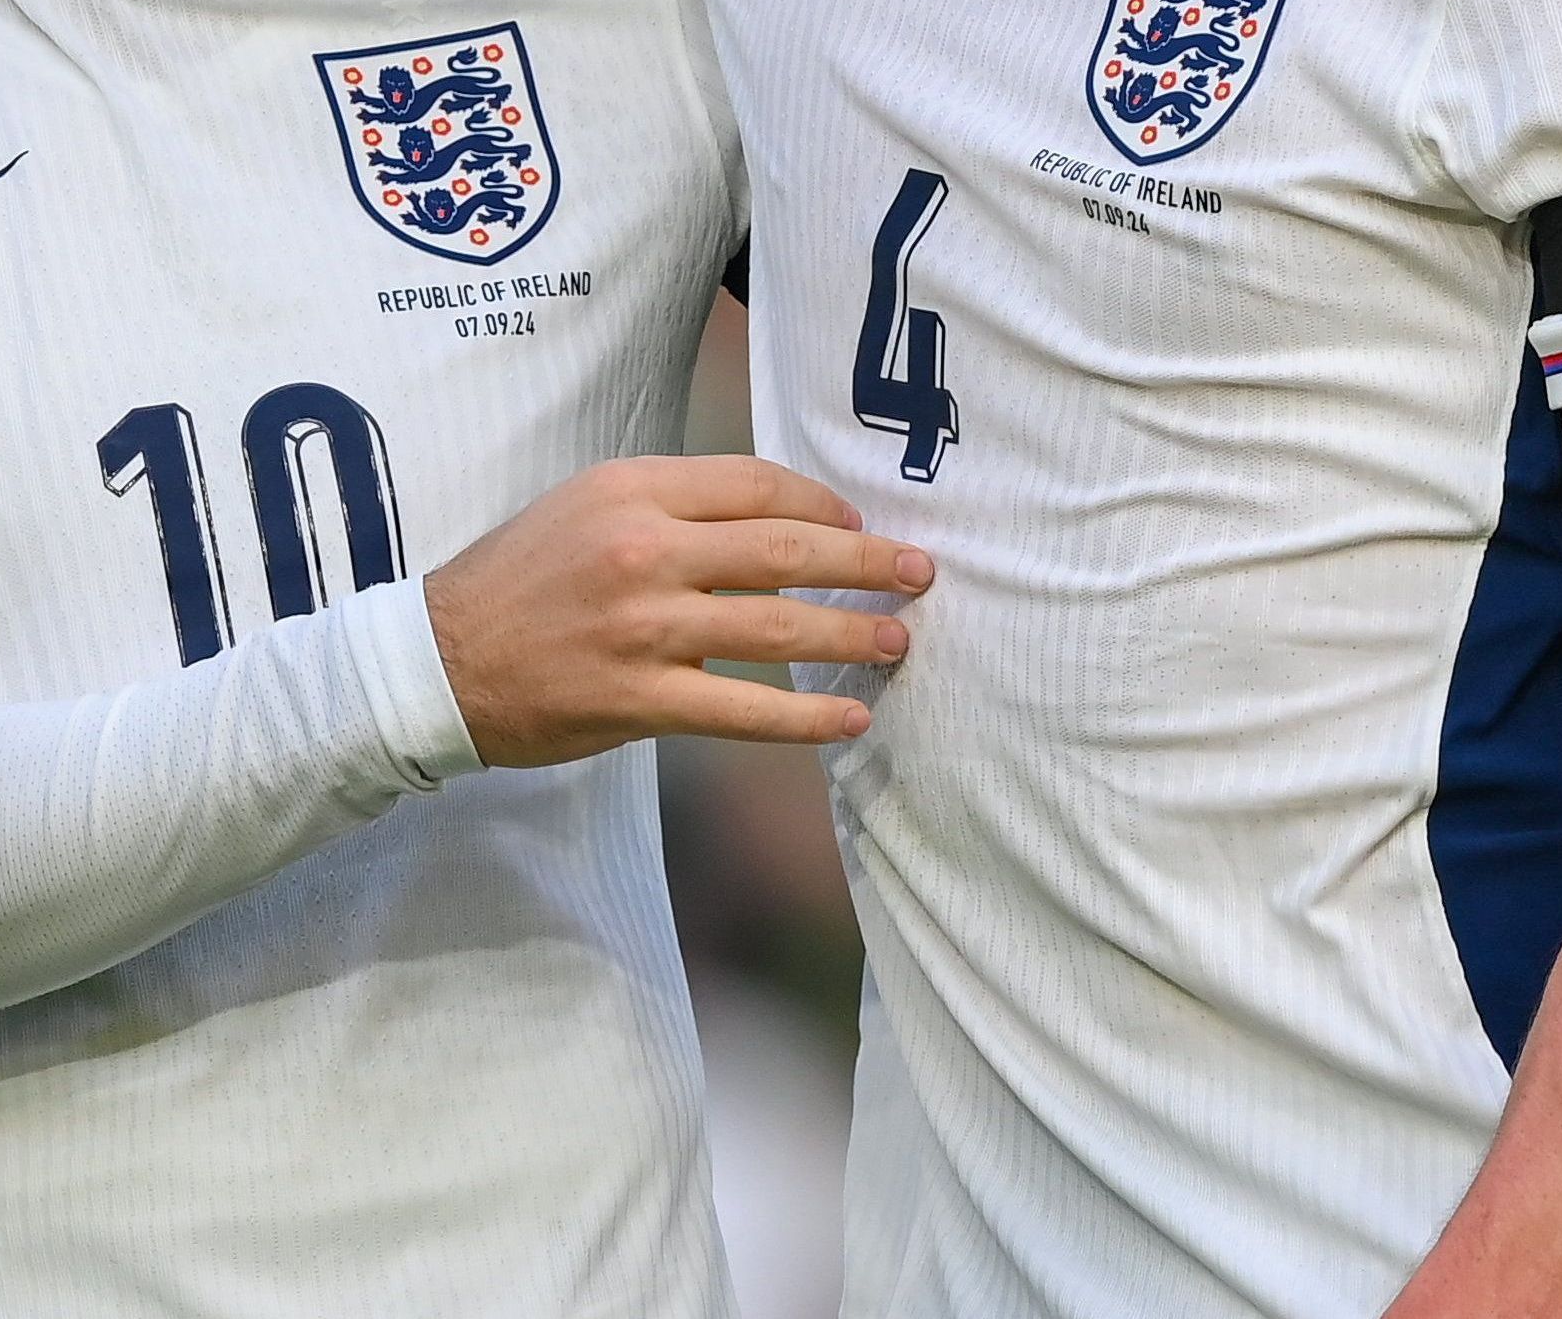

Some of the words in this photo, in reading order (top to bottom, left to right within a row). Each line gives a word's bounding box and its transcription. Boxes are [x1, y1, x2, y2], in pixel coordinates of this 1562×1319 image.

[1030, 149, 1112, 188] REPUBLIC
[1109, 172, 1136, 195] OF
[1137, 176, 1222, 214] IRELAND
[1082, 197, 1151, 235] 07.09.24
[377, 284, 477, 313] REPUBLIC
[481, 280, 507, 303] OF
[511, 271, 592, 299] IRELAND
[454, 310, 536, 338] 07.09.24
[852, 167, 959, 484] 4
[96, 382, 407, 668] 10
